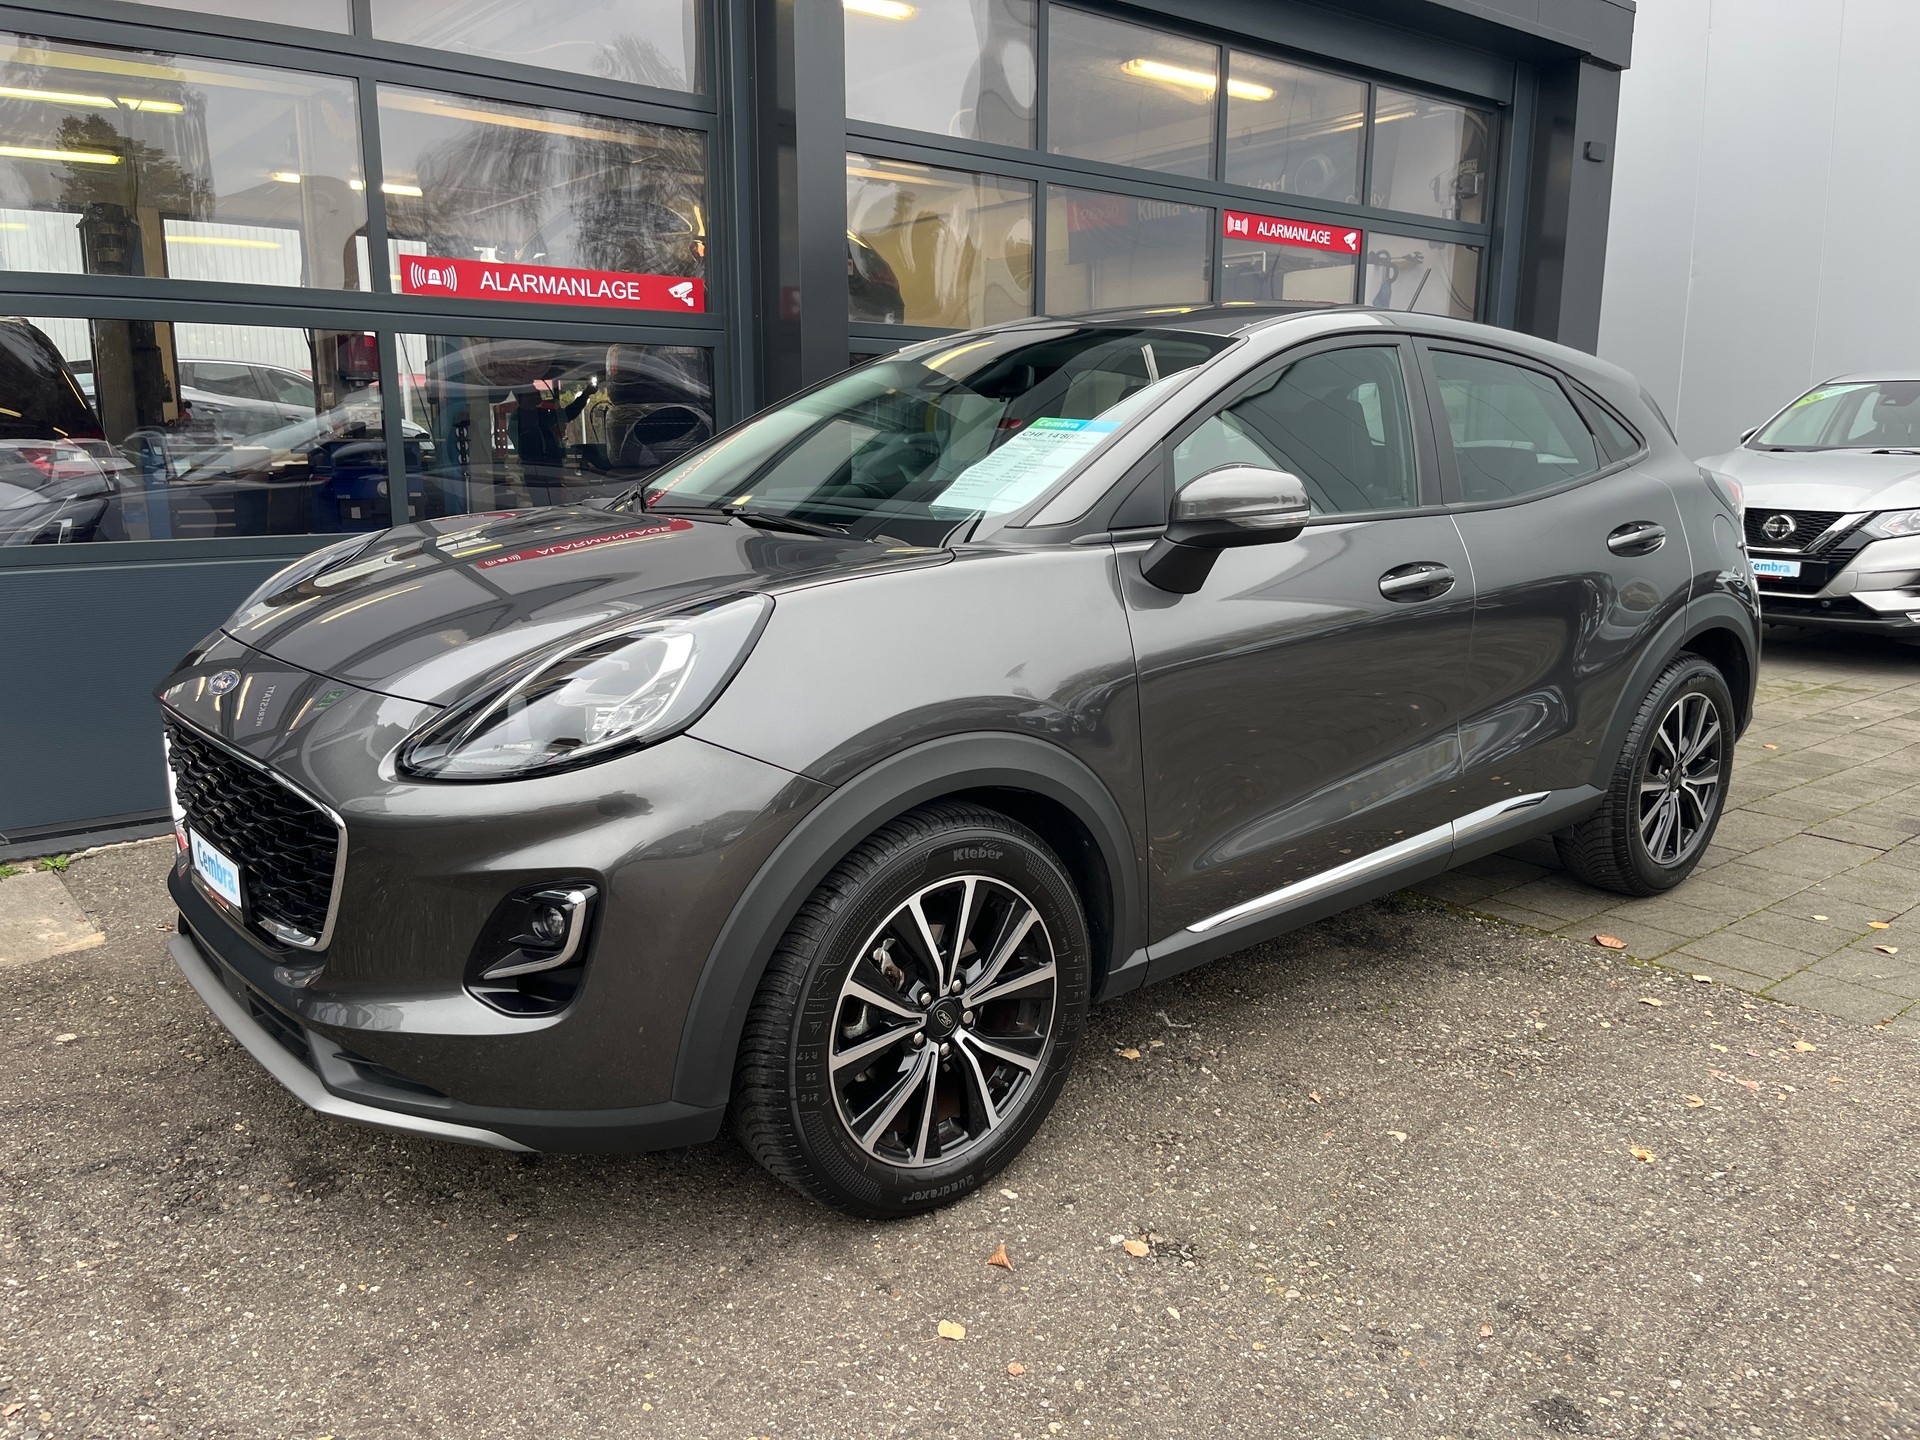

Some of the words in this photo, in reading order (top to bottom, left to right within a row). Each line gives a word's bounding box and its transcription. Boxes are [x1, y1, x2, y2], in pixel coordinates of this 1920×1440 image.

[1257, 221, 1331, 246] ALARMANLAGE
[479, 270, 641, 301] ALARMANLAGE
[1037, 420, 1080, 429] Cembra
[1750, 561, 1791, 573] embra
[952, 846, 1004, 862] Kleber
[197, 840, 237, 896] Cembra
